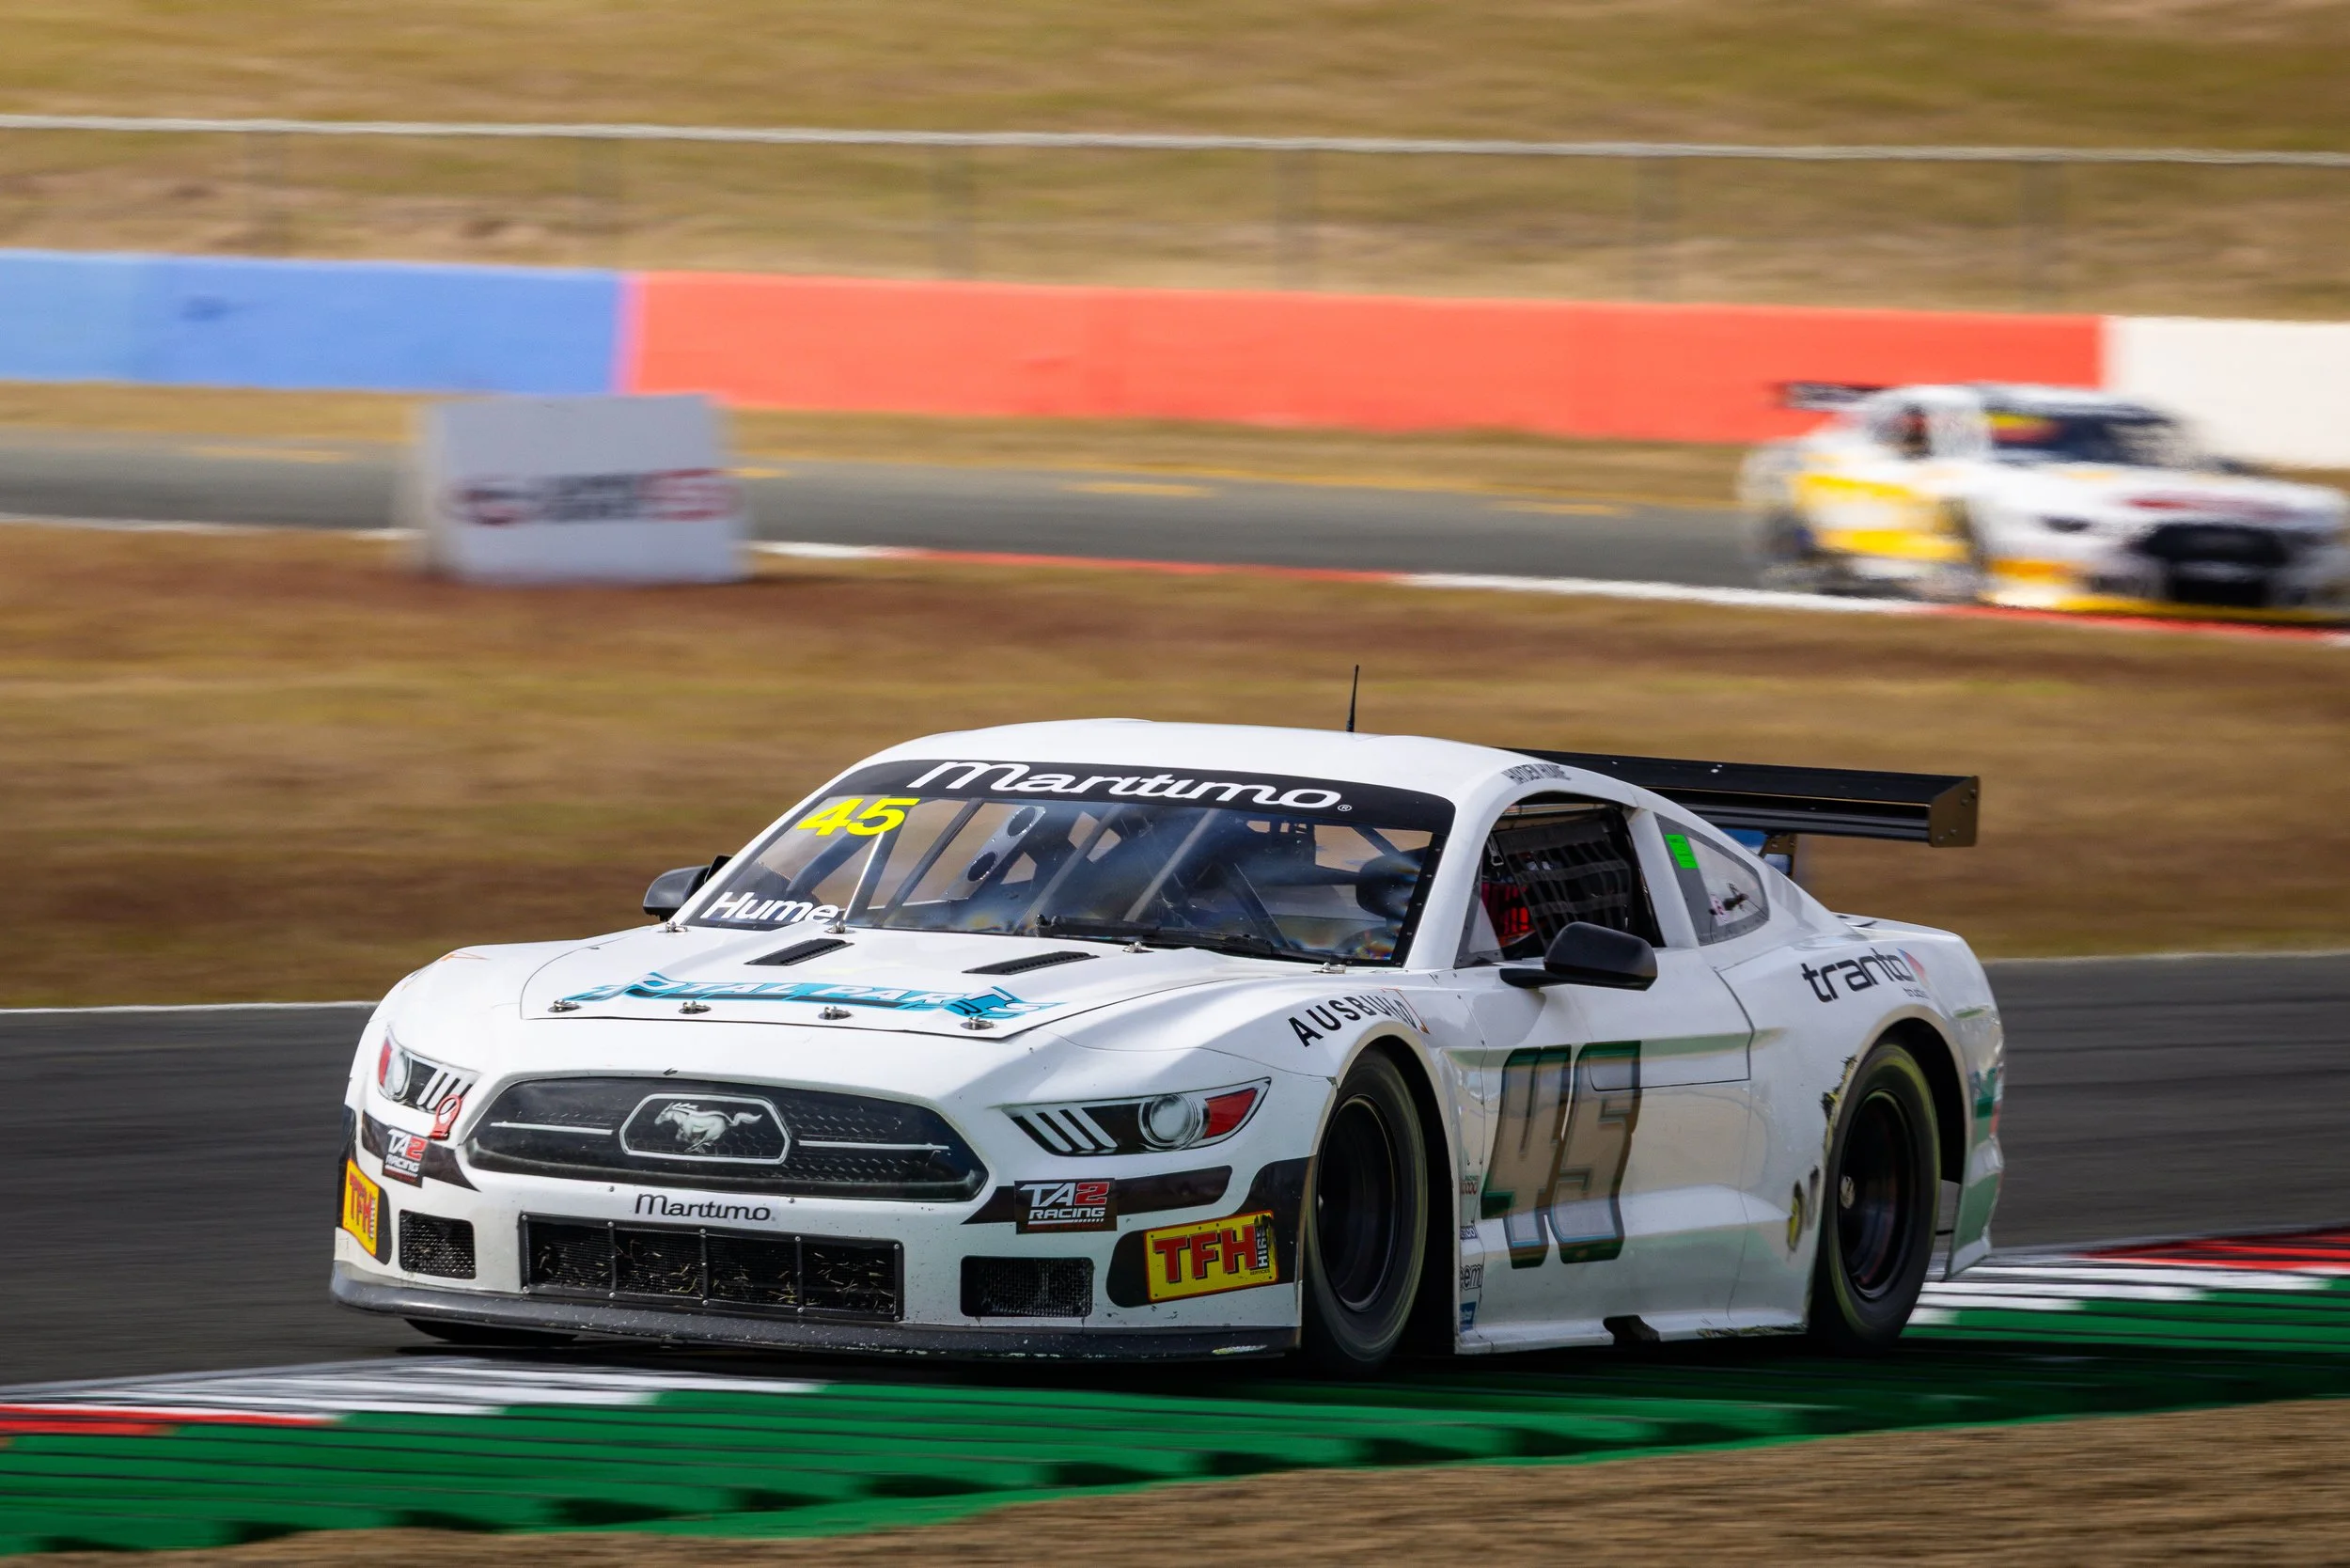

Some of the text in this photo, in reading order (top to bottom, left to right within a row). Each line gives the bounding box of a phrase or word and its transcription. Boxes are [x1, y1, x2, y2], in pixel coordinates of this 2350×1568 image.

[905, 760, 1342, 809] Maritimo
[797, 798, 920, 836] 45
[699, 892, 839, 924] Hume
[387, 1128, 430, 1162] TA2
[1480, 1040, 1642, 1269] 45
[384, 1153, 421, 1173] RACING
[634, 1193, 772, 1221] Maritimo
[1019, 1181, 1110, 1208] TA2
[1028, 1207, 1106, 1220] RACING
[1152, 1225, 1260, 1283] TFH
